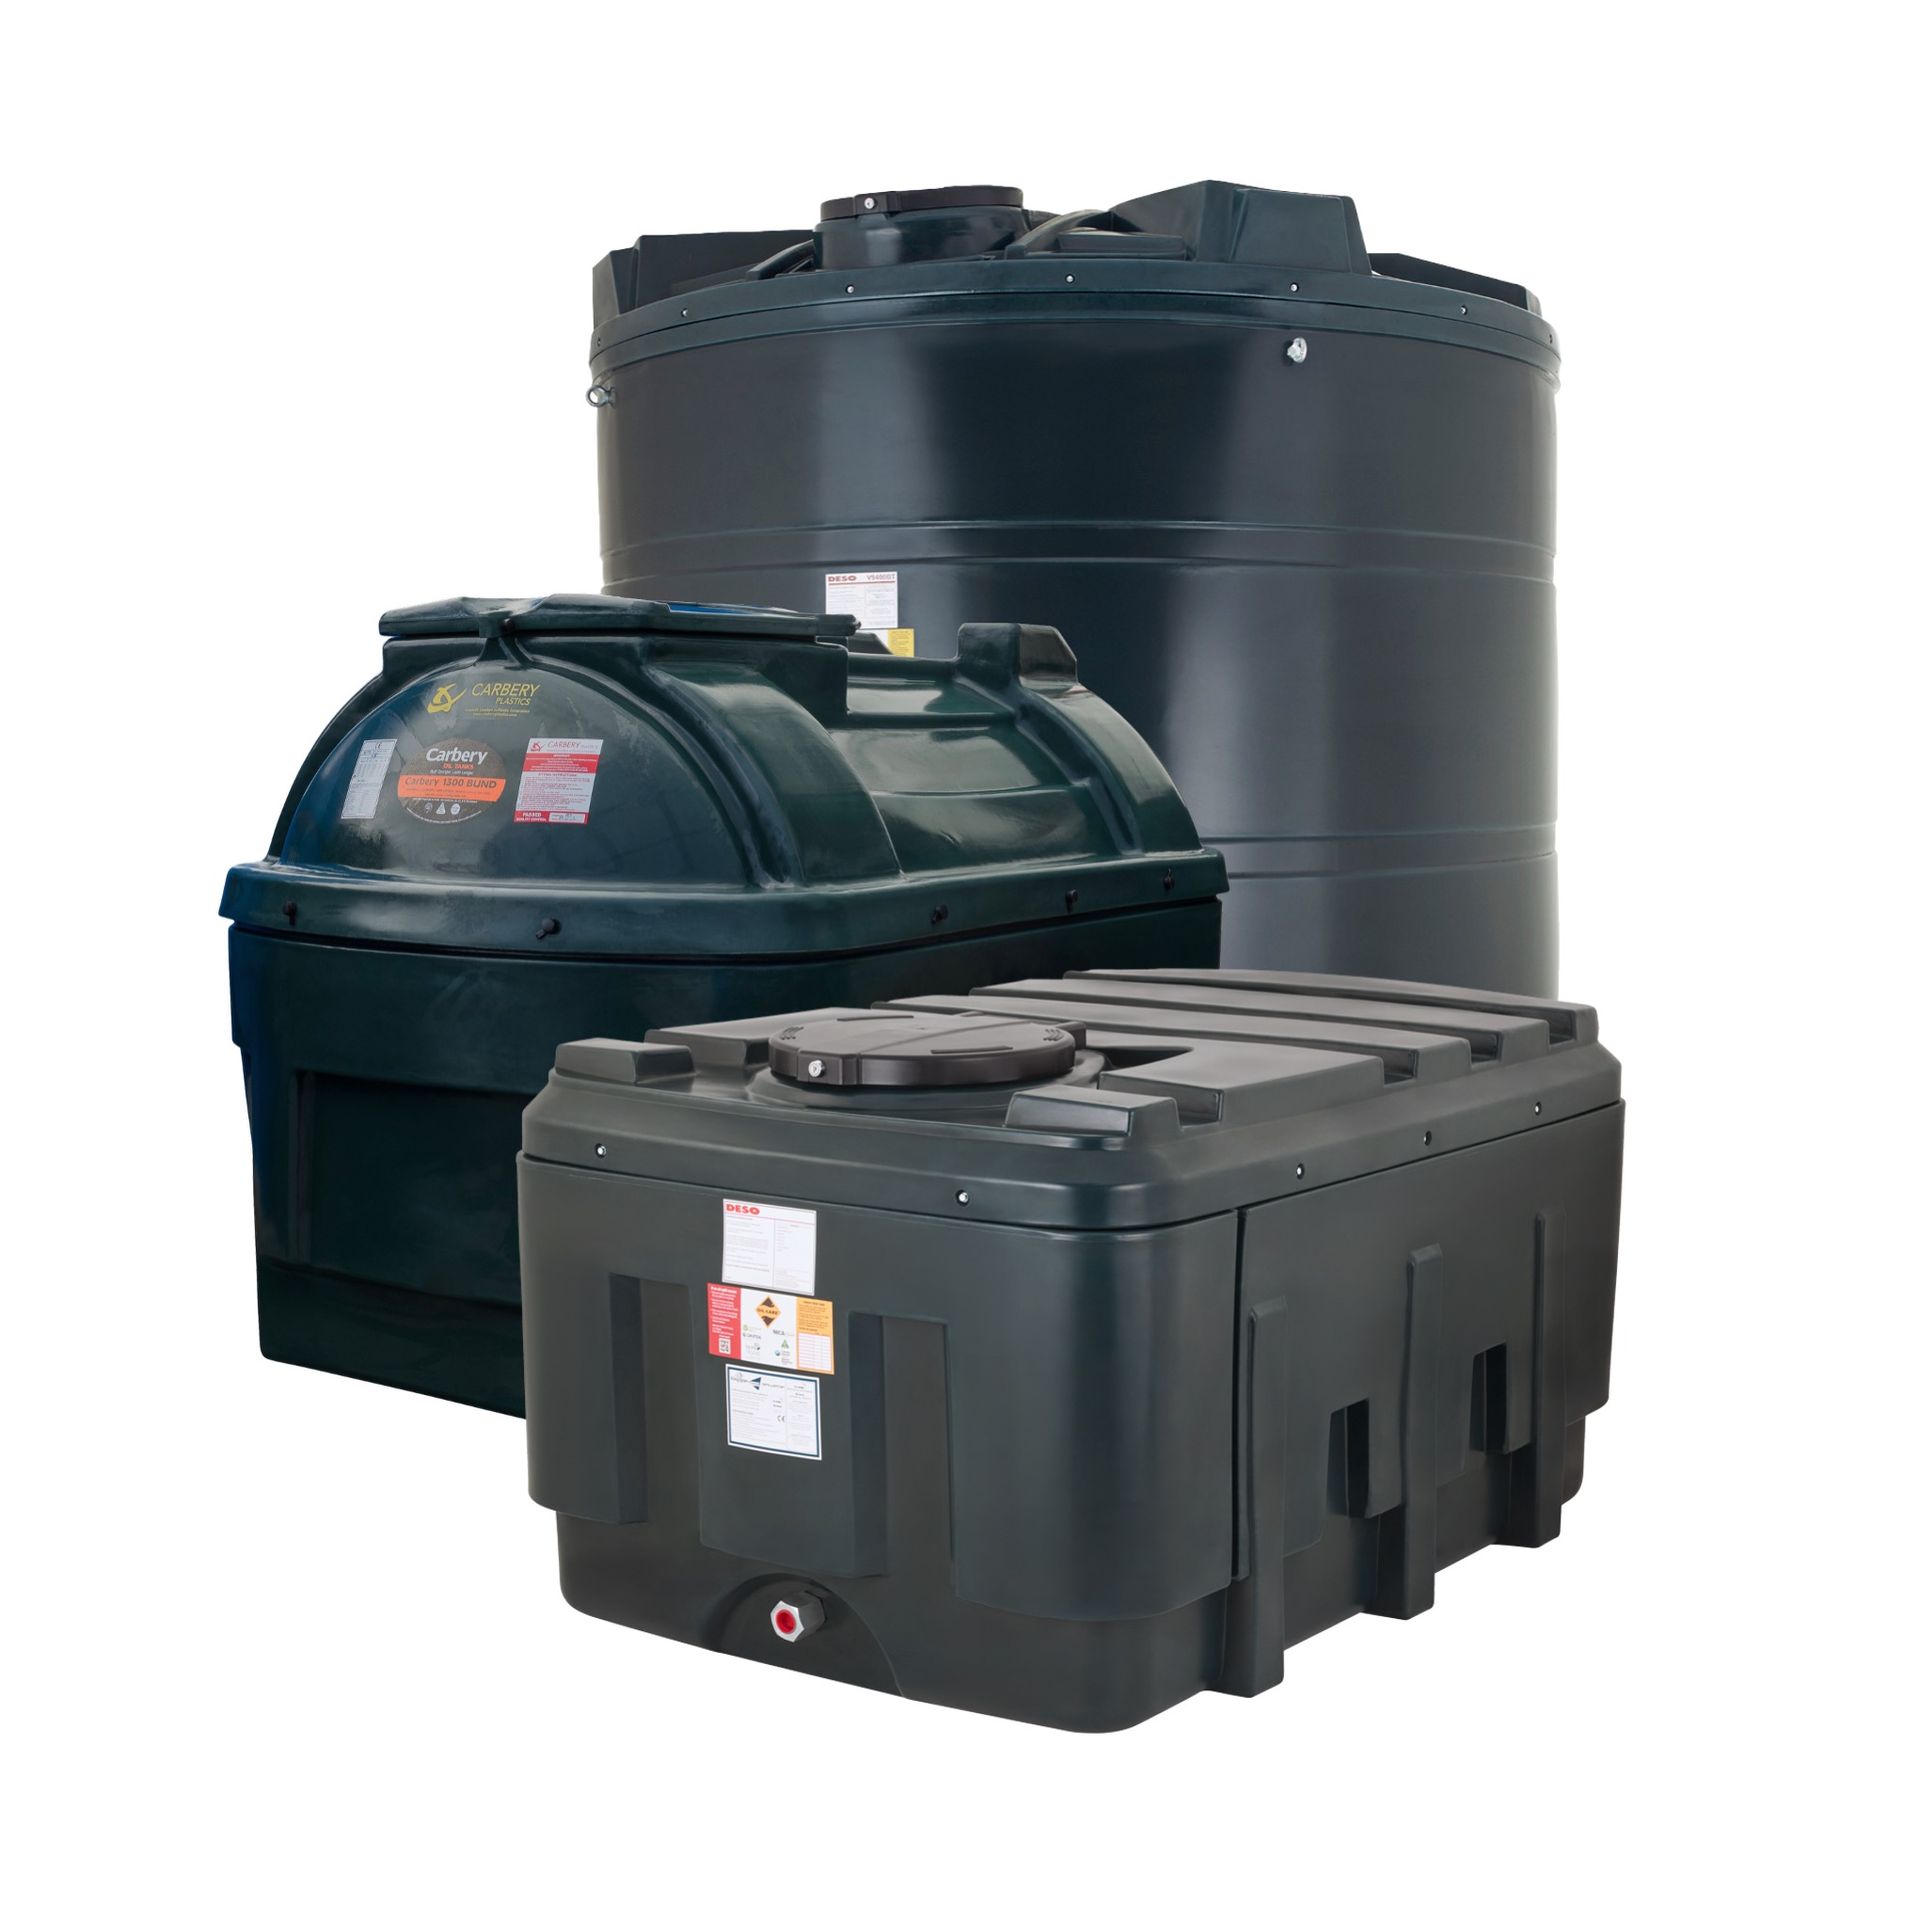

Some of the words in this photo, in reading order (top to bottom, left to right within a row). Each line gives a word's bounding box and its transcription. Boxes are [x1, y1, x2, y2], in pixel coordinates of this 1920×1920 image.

[471, 682, 541, 697] CARBERY
[495, 697, 532, 706] PLASTICS
[547, 741, 581, 749] CARBERY
[425, 747, 489, 765] Carbery
[405, 776, 439, 788] Carbery
[466, 778, 498, 789] BUND
[726, 1203, 760, 1215] DESO
